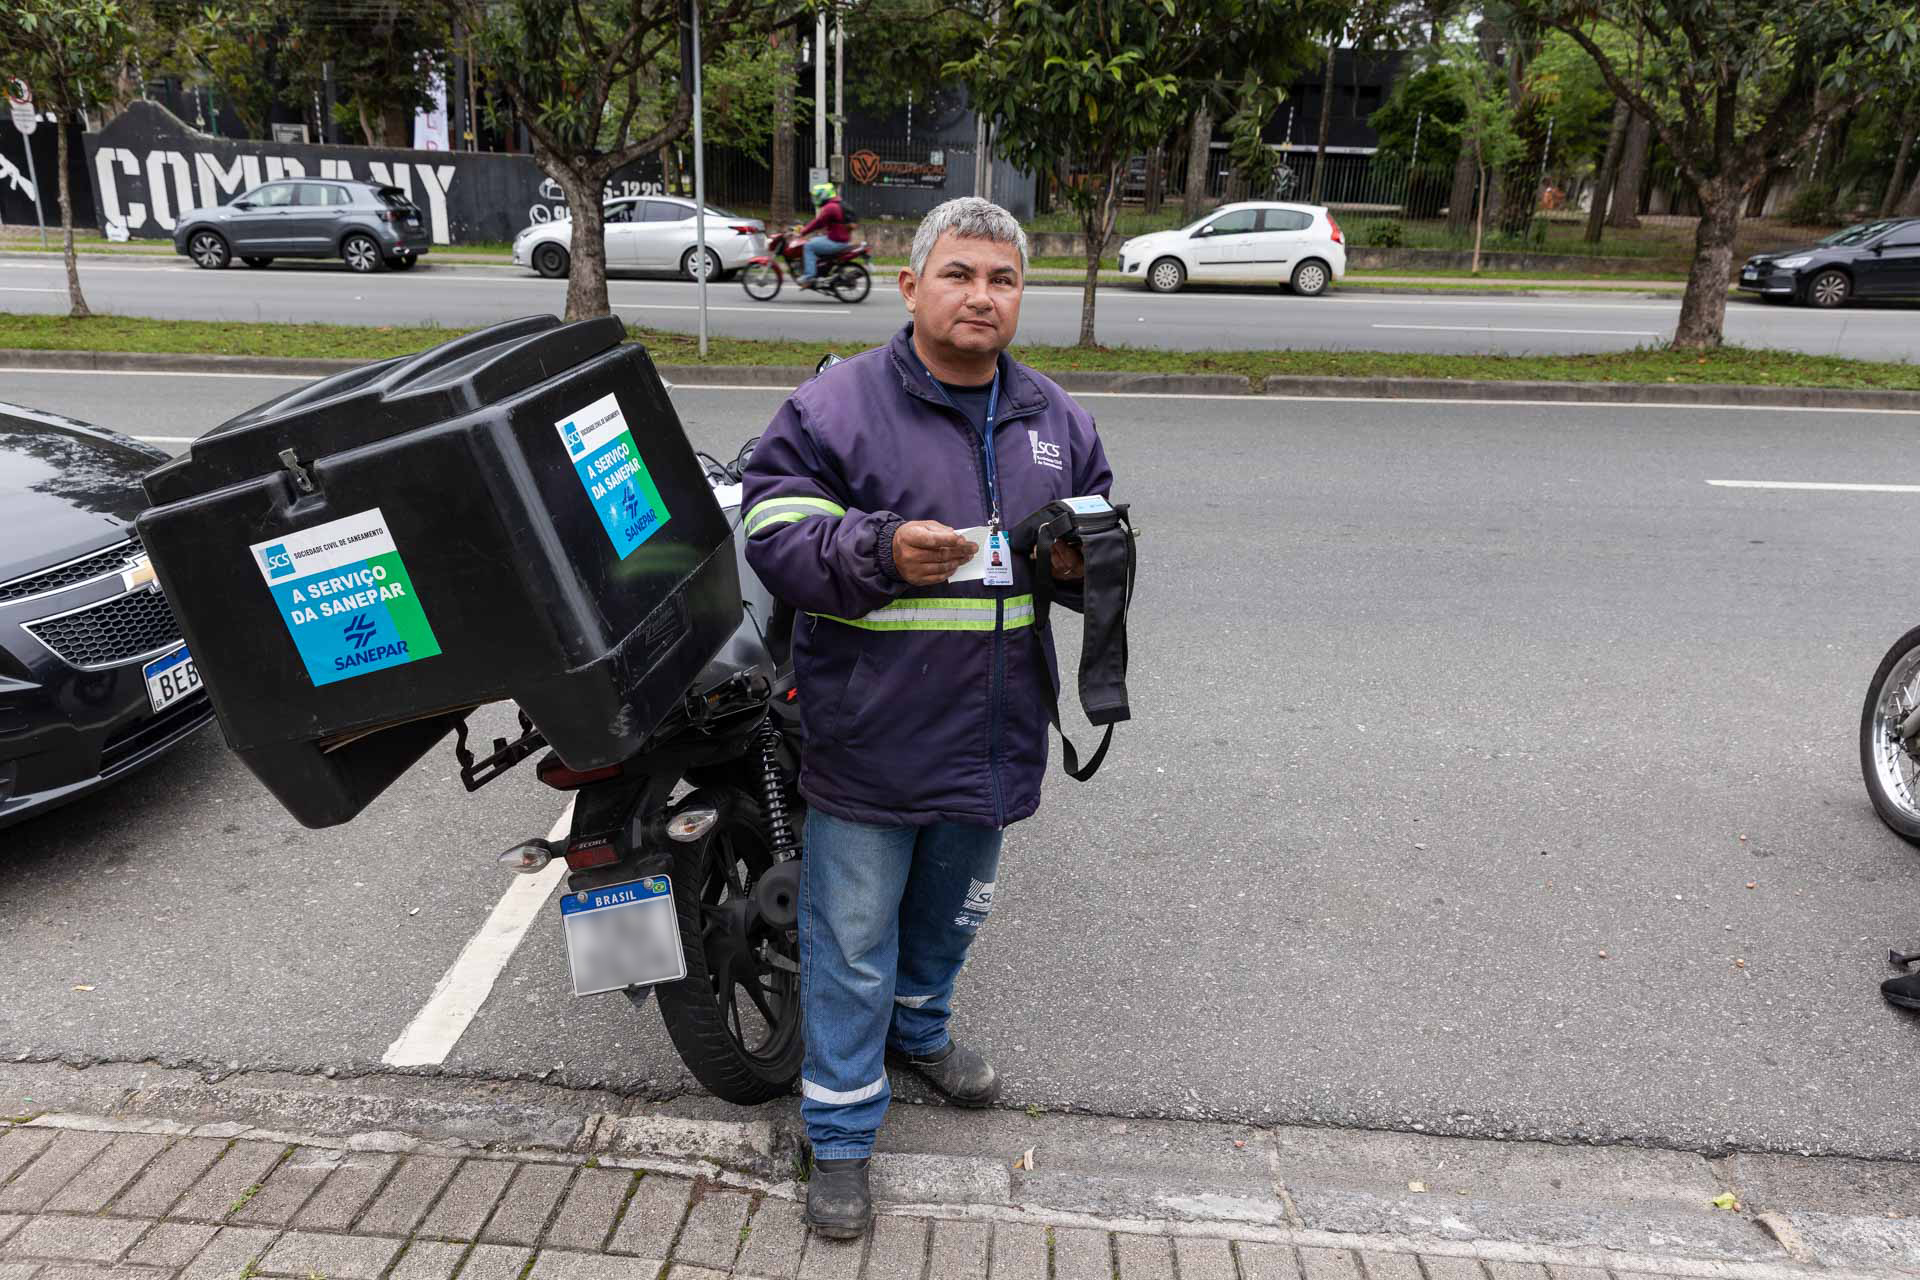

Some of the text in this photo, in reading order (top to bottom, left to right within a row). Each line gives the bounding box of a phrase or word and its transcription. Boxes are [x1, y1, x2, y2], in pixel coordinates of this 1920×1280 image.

[95, 148, 456, 245] COMY
[586, 442, 630, 480] A SERVIÇO
[1036, 441, 1060, 457] SCS
[591, 458, 641, 500] DA SANEPAR
[625, 509, 659, 542] SANEPAR
[268, 552, 290, 570] SCS
[293, 528, 384, 560] SOCIEDADE CIVIL DE SANEAMENTO
[292, 565, 387, 604] A SERVIÇO
[291, 582, 406, 625] DA SANEPAR
[334, 640, 409, 671] SANEPAR
[159, 661, 199, 701] BEB
[595, 890, 637, 907] BRASIL
